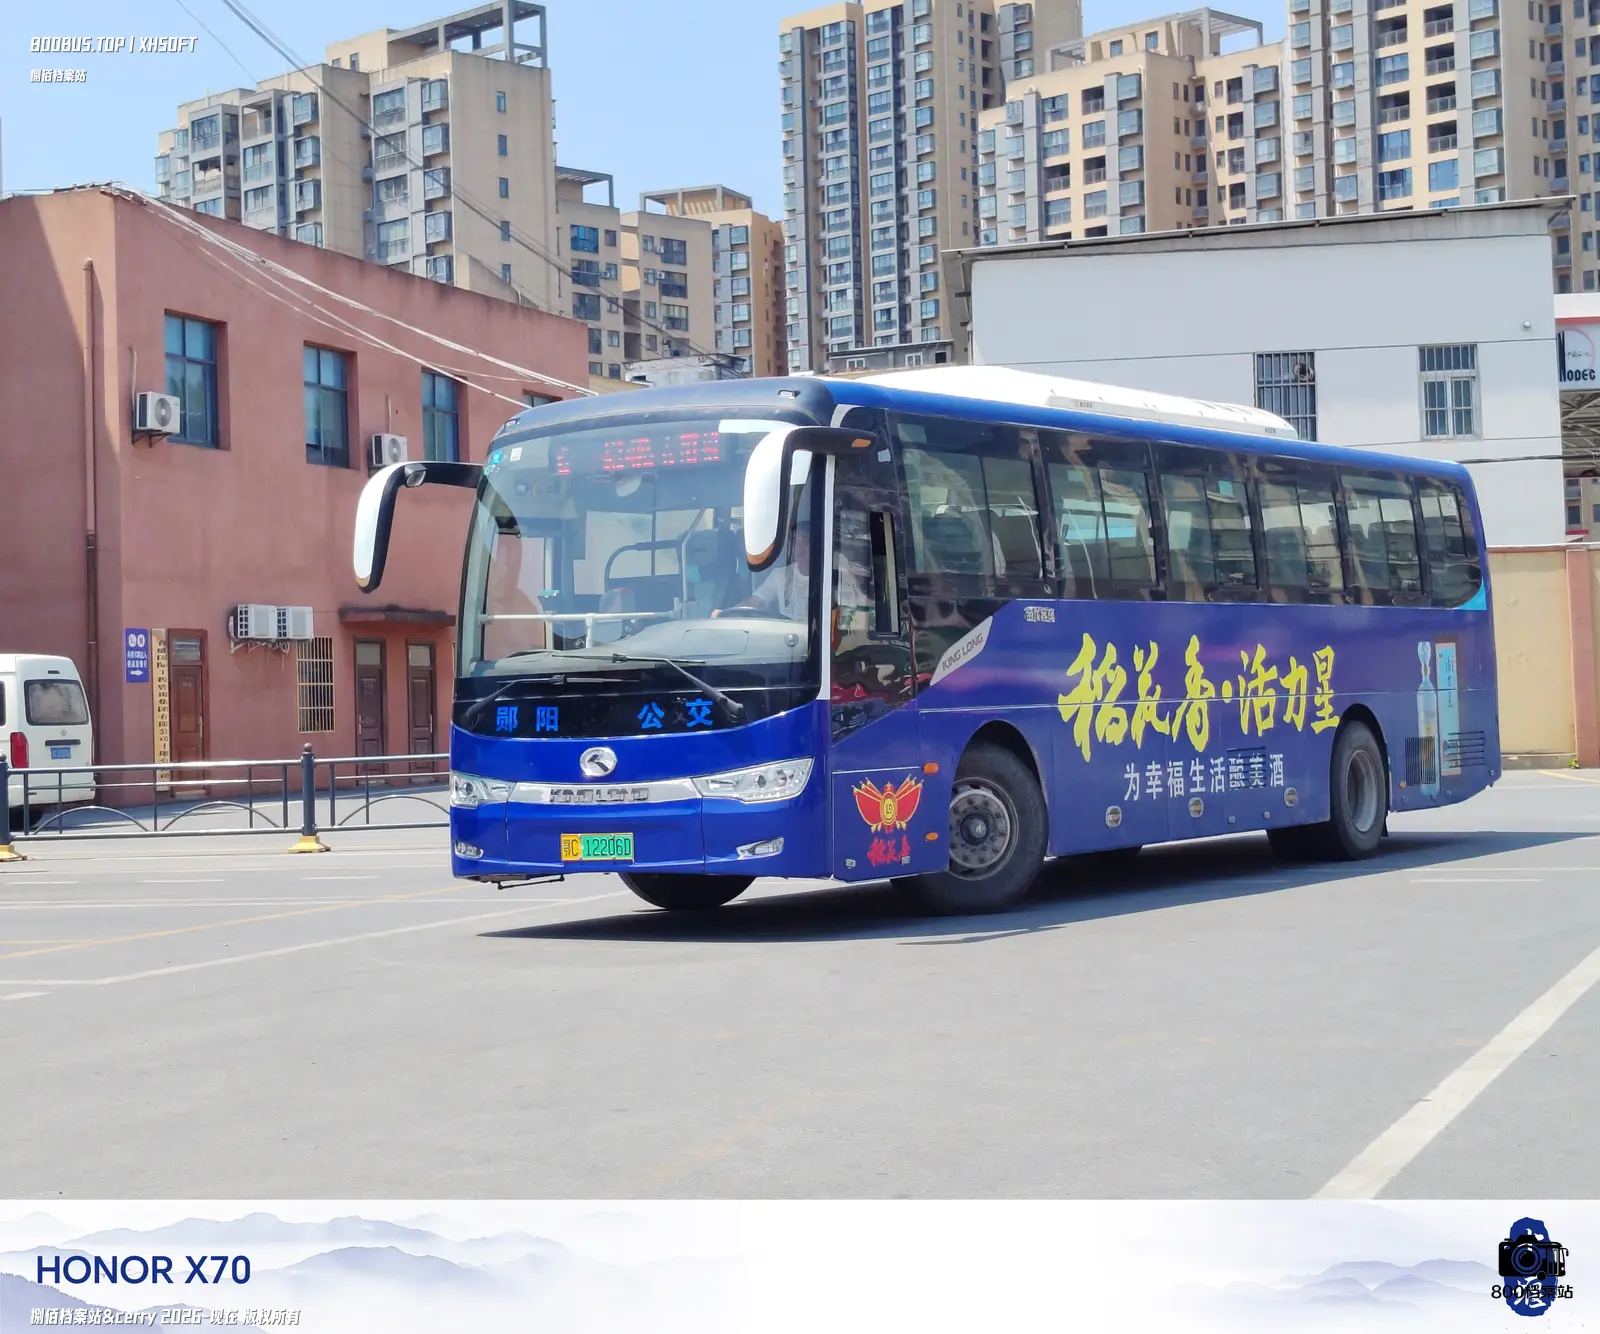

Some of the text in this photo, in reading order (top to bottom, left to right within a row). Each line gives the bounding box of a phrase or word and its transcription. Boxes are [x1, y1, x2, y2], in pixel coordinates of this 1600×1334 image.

[942, 632, 983, 671] KING LONG
[495, 698, 714, 733] 郧阳 公交
